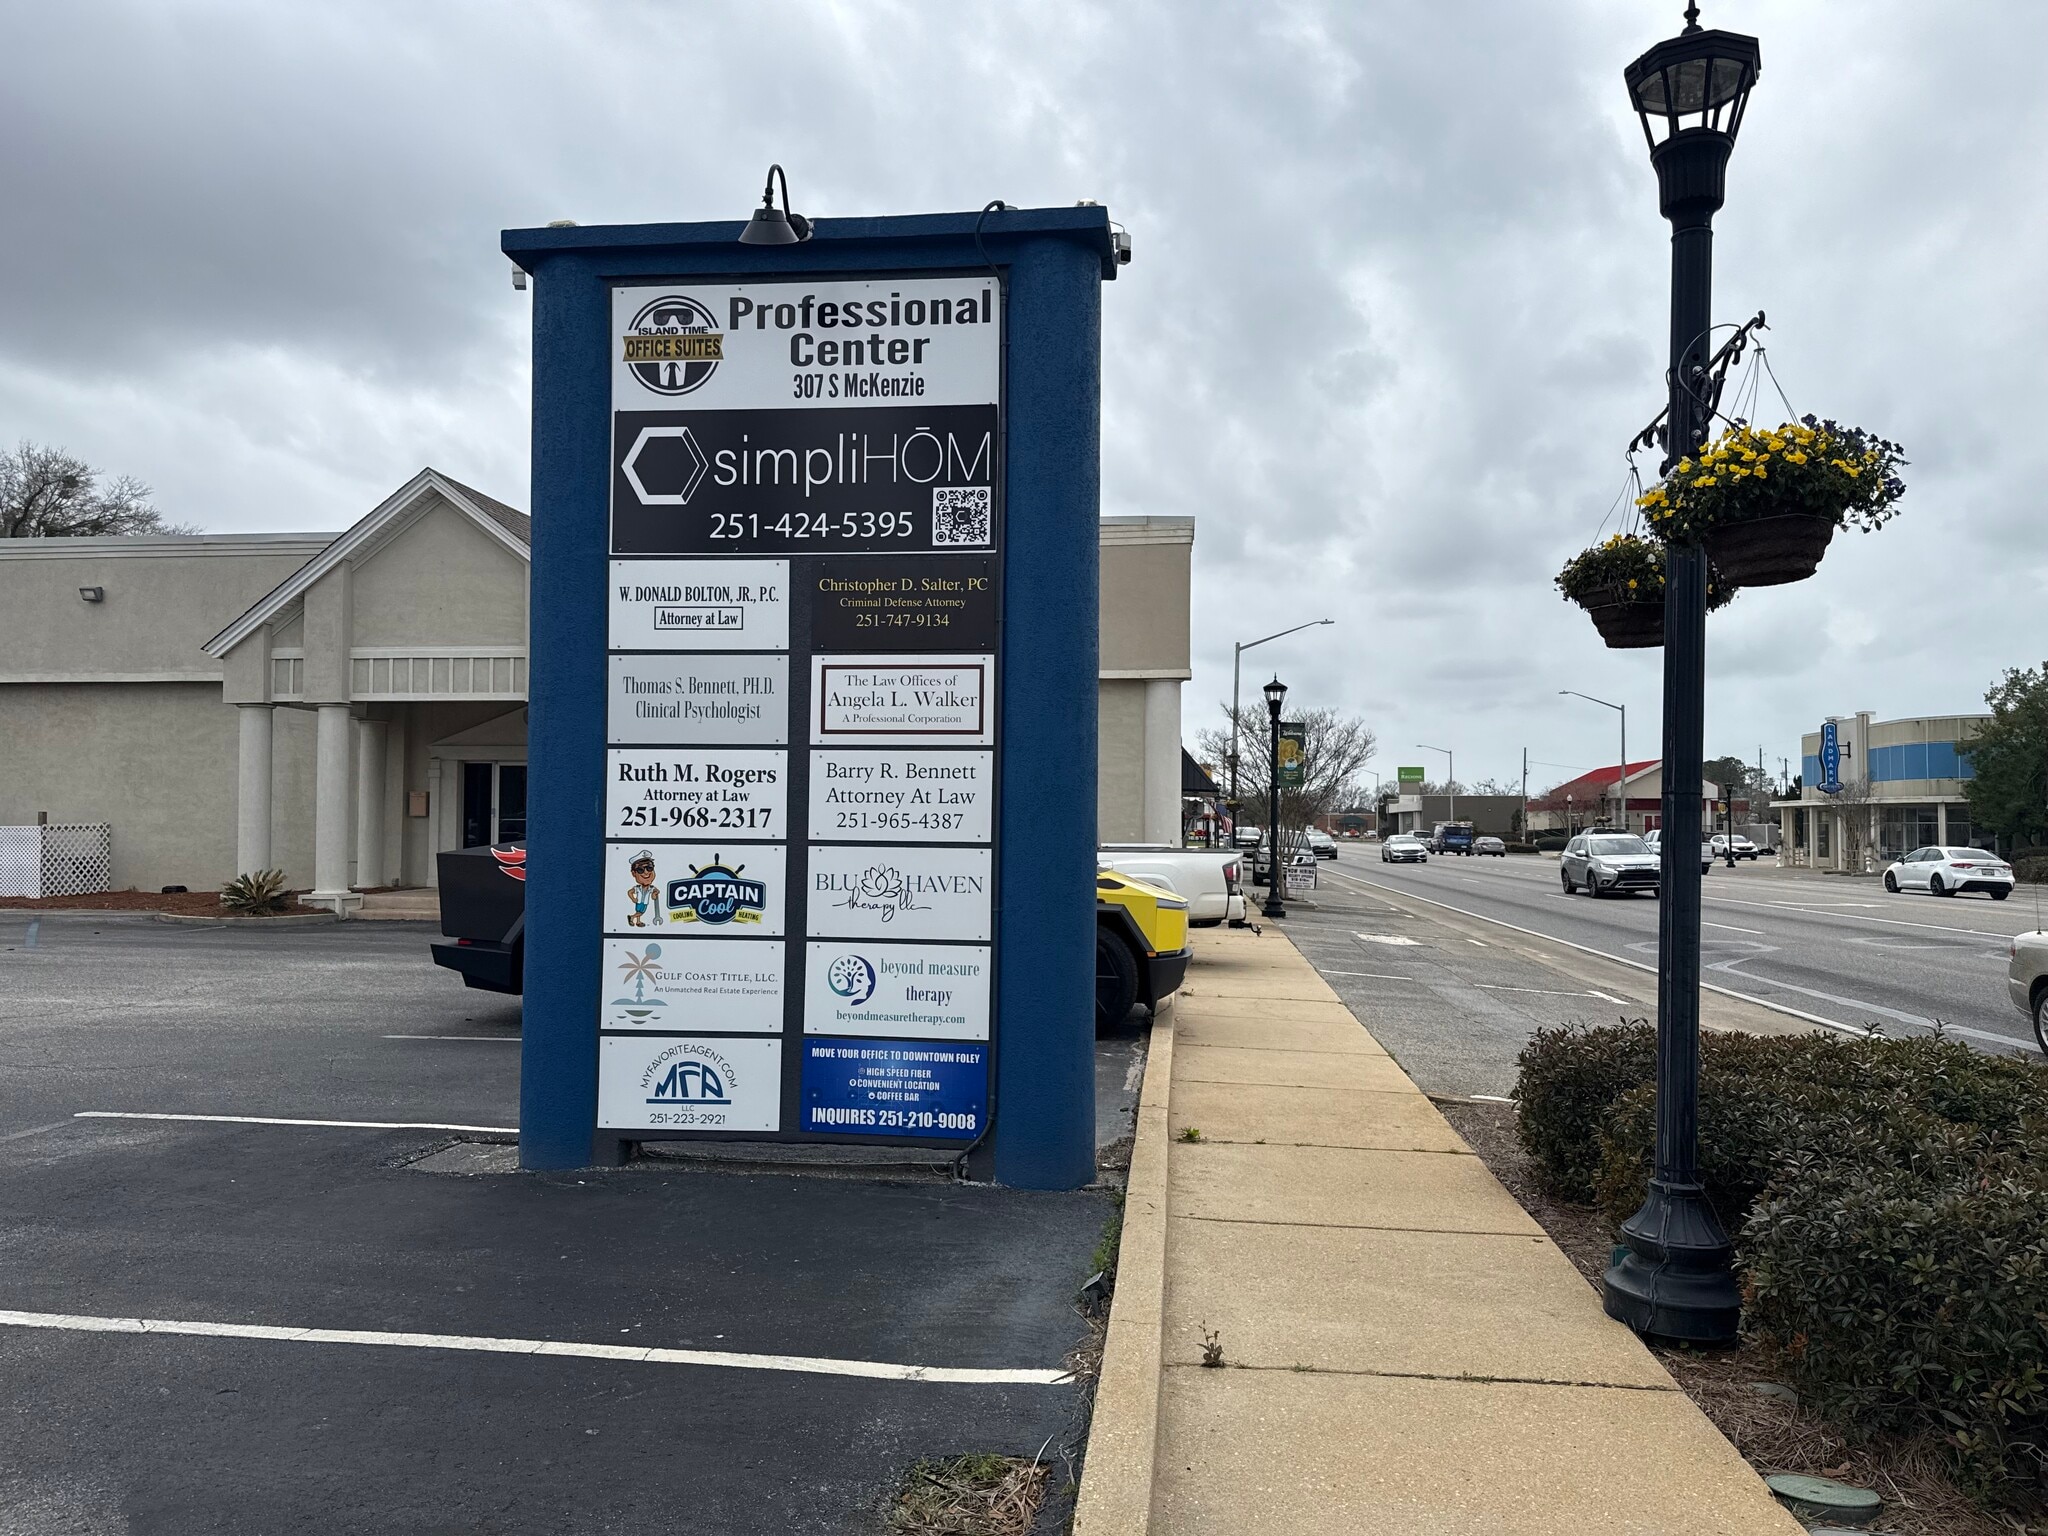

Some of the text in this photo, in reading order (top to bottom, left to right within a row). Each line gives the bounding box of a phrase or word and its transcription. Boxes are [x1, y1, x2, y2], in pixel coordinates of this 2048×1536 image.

[729, 290, 991, 330] Professional
[639, 326, 708, 335] ISLAND TIME
[627, 338, 720, 357] OFFICE SUITES
[791, 334, 930, 367] Center
[794, 372, 924, 398] 307 S McKenzie
[710, 511, 913, 538] 251-424-5395
[619, 587, 778, 603] W. DONALD BOLTON, JR., P.C.
[819, 578, 988, 594] Christopher D. Salter, PC
[840, 598, 966, 609] Criminal Defense Attorney
[660, 610, 738, 627] Attorney at Law
[856, 614, 949, 627] 251-747-9134
[623, 677, 774, 696] Thomas S. Bennett, PH.D.
[845, 675, 958, 686] The Law Offices of
[828, 691, 978, 710] Angela L. Walker
[636, 701, 761, 724] Clinical Psychologist
[853, 714, 905, 722] Professional
[908, 714, 961, 724] Corporation
[619, 763, 777, 787] Ruth M. Rogers
[826, 763, 976, 783] Barry R. Bennett
[644, 788, 750, 804] Attorney at Law
[826, 788, 975, 808] Attorney At Law
[621, 806, 772, 828] 251-968-2317
[837, 812, 964, 829] 251-965-4387
[816, 873, 983, 893] BLU HAVEN
[675, 884, 758, 902] CAPTAIN
[698, 897, 734, 915] Cool
[832, 886, 895, 922] therapy
[673, 911, 759, 920] COOLING HEATING
[881, 958, 979, 978] beyond measure
[755, 973, 778, 982] LLC.
[742, 988, 778, 996] Experience
[906, 986, 952, 1006] therapy
[836, 1010, 965, 1025] beyondmeasuretherapy.com
[812, 1048, 980, 1063] MOVE YOUR OFFICE TO DOWNTOWN FOLEY
[640, 1044, 738, 1088] MYFAVORITEAGENT.COM
[867, 1068, 931, 1078] HIGH SPEED FIBER
[858, 1079, 940, 1090] CONVENIENT LOCATION
[877, 1092, 919, 1101] COFFEE BAR
[650, 1113, 725, 1124] 251-223-2921
[812, 1108, 976, 1130] INQUIRES 251-210-9008
